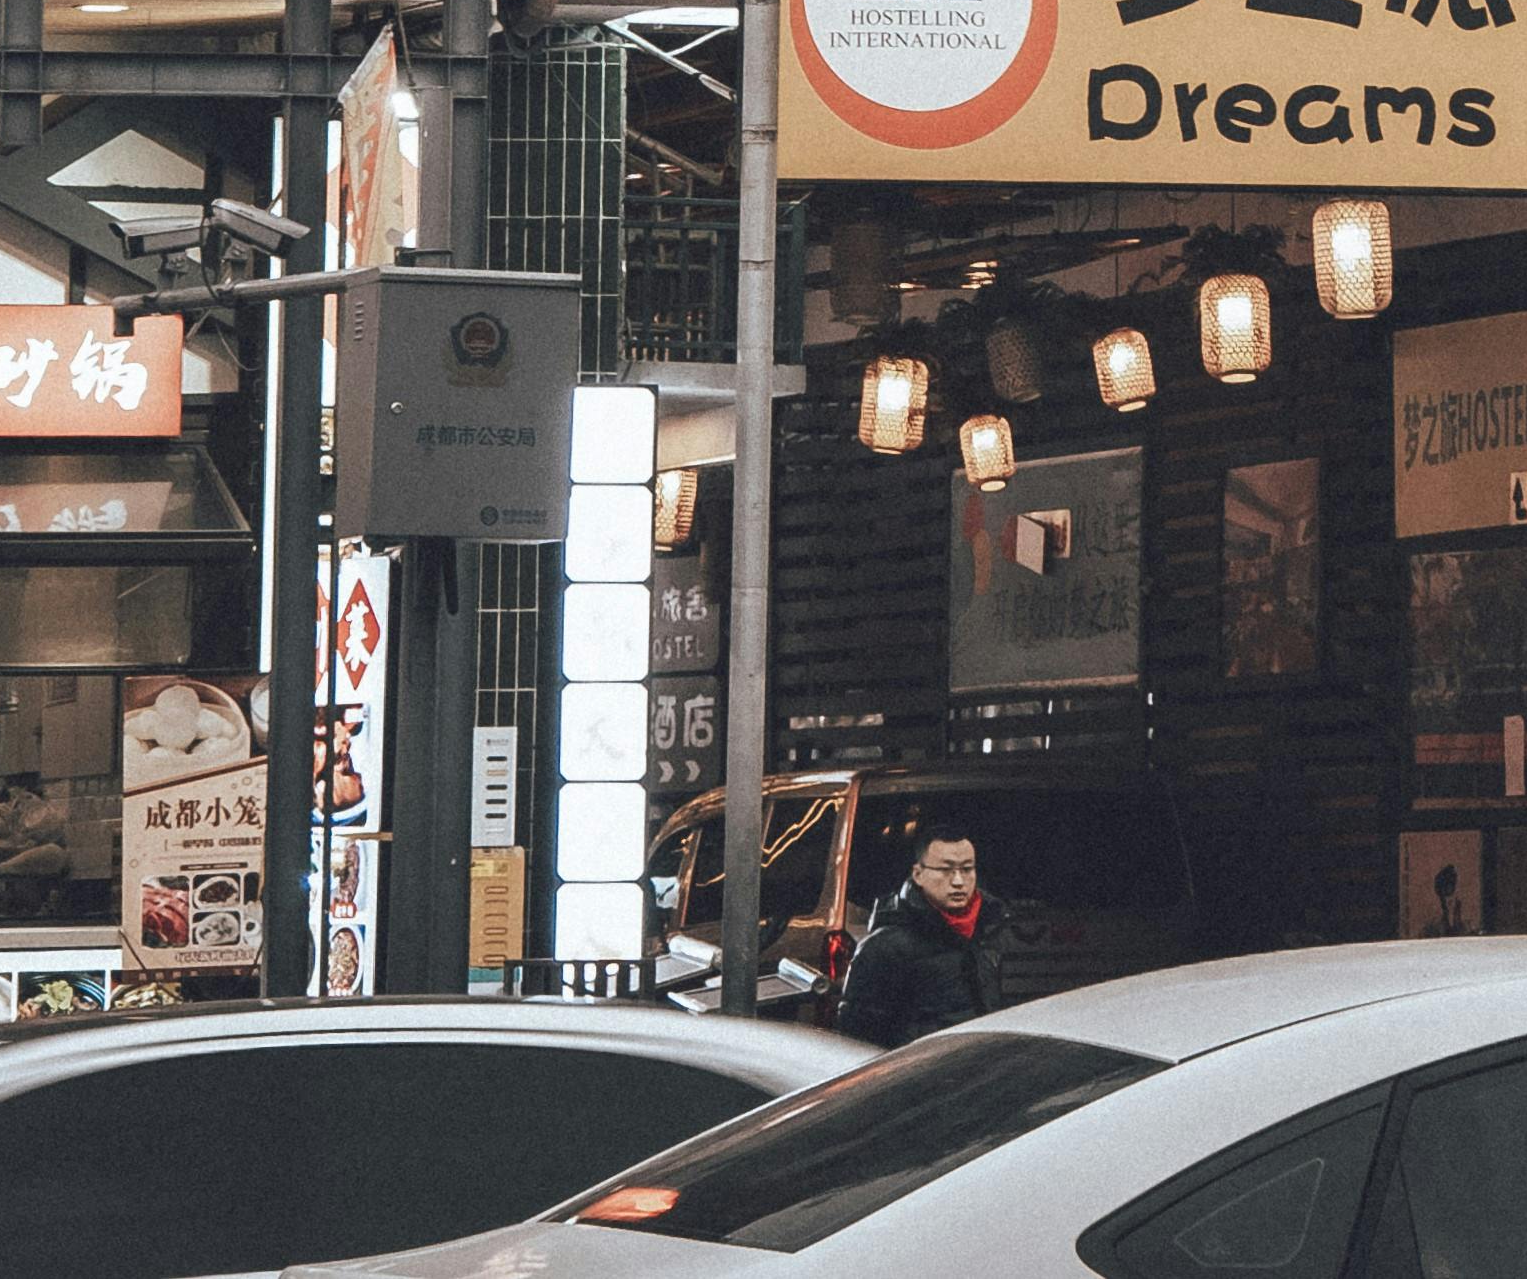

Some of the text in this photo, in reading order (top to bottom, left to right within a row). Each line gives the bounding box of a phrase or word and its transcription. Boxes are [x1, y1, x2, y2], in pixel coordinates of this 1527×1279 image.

[850, 9, 986, 27] HOSTELLING
[829, 31, 1007, 50] INTERNATIONAL
[1086, 59, 1497, 147] Dreams
[416, 425, 536, 448] 成都市公安局
[653, 585, 707, 622] 旅舍
[652, 635, 704, 661] OSTEL
[145, 795, 267, 831] 成都小笼
